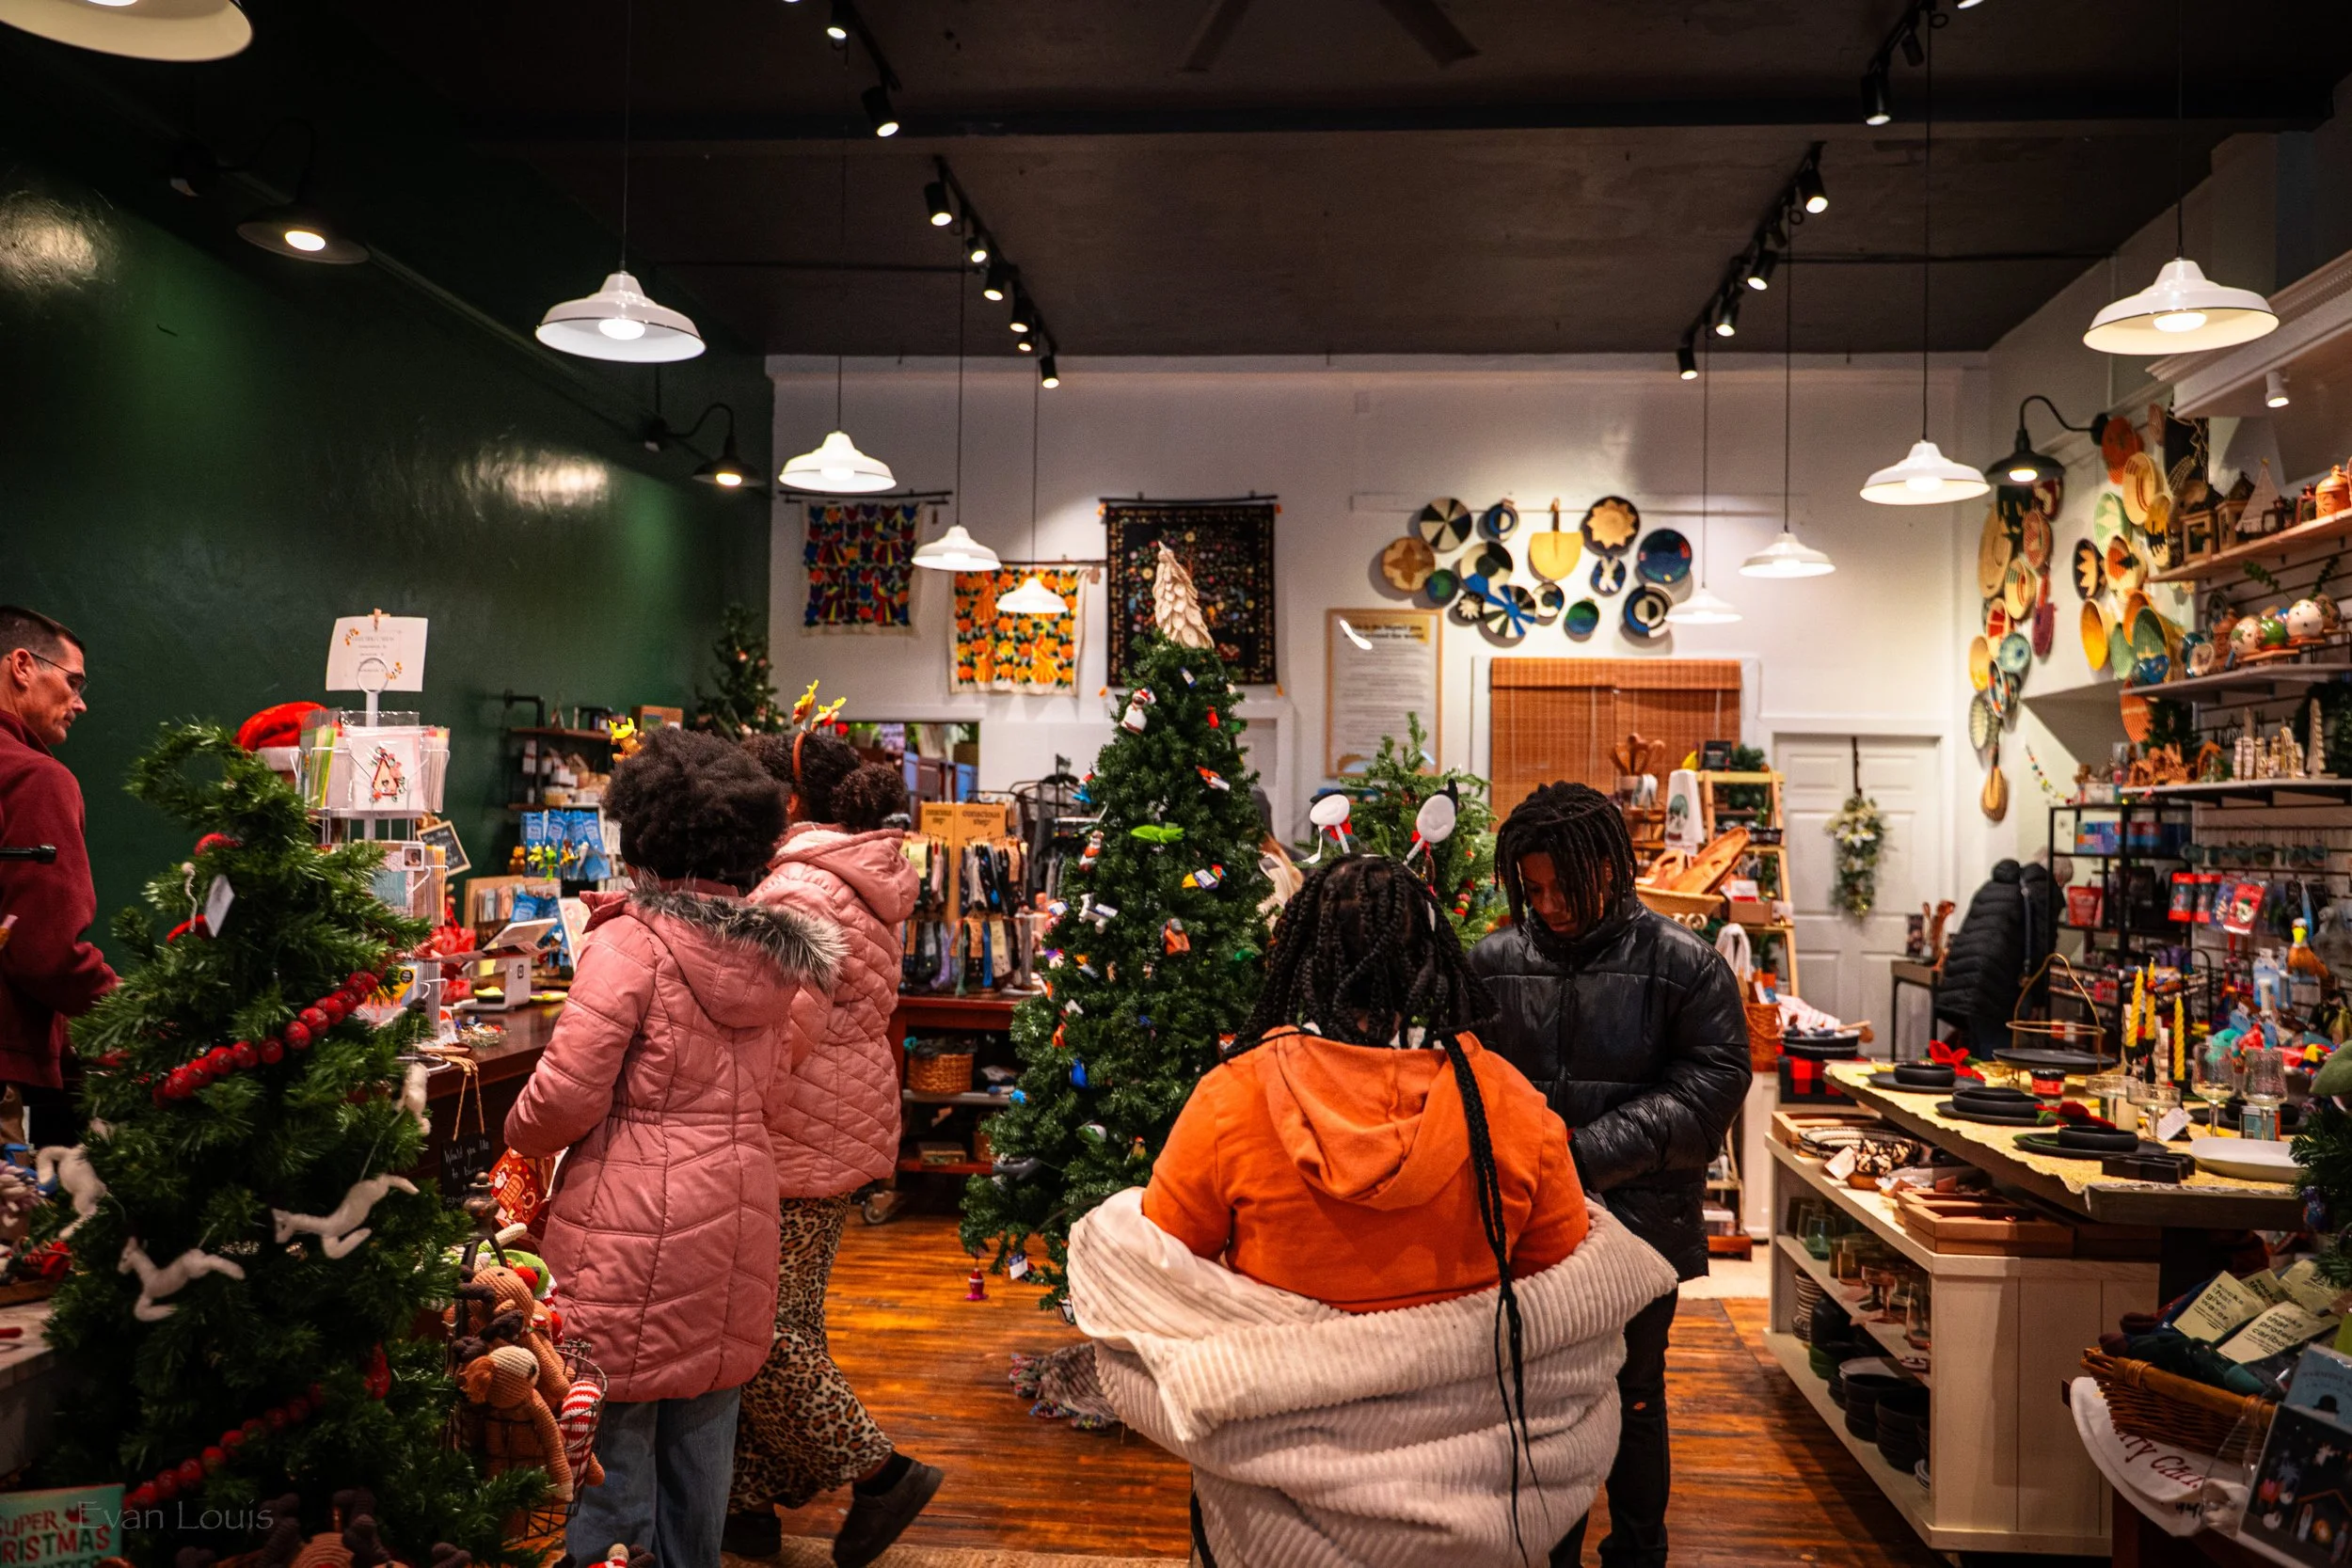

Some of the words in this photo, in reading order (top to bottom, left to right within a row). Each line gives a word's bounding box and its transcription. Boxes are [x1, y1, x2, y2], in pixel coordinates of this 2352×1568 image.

[2205, 1293, 2227, 1311] give
[2213, 1288, 2233, 1306] that
[2217, 1283, 2244, 1305] socks
[2266, 1315, 2289, 1329] that
[2273, 1311, 2304, 1329] socks
[0, 1511, 59, 1537] UPER
[0, 1525, 111, 1564] RISTMAS
